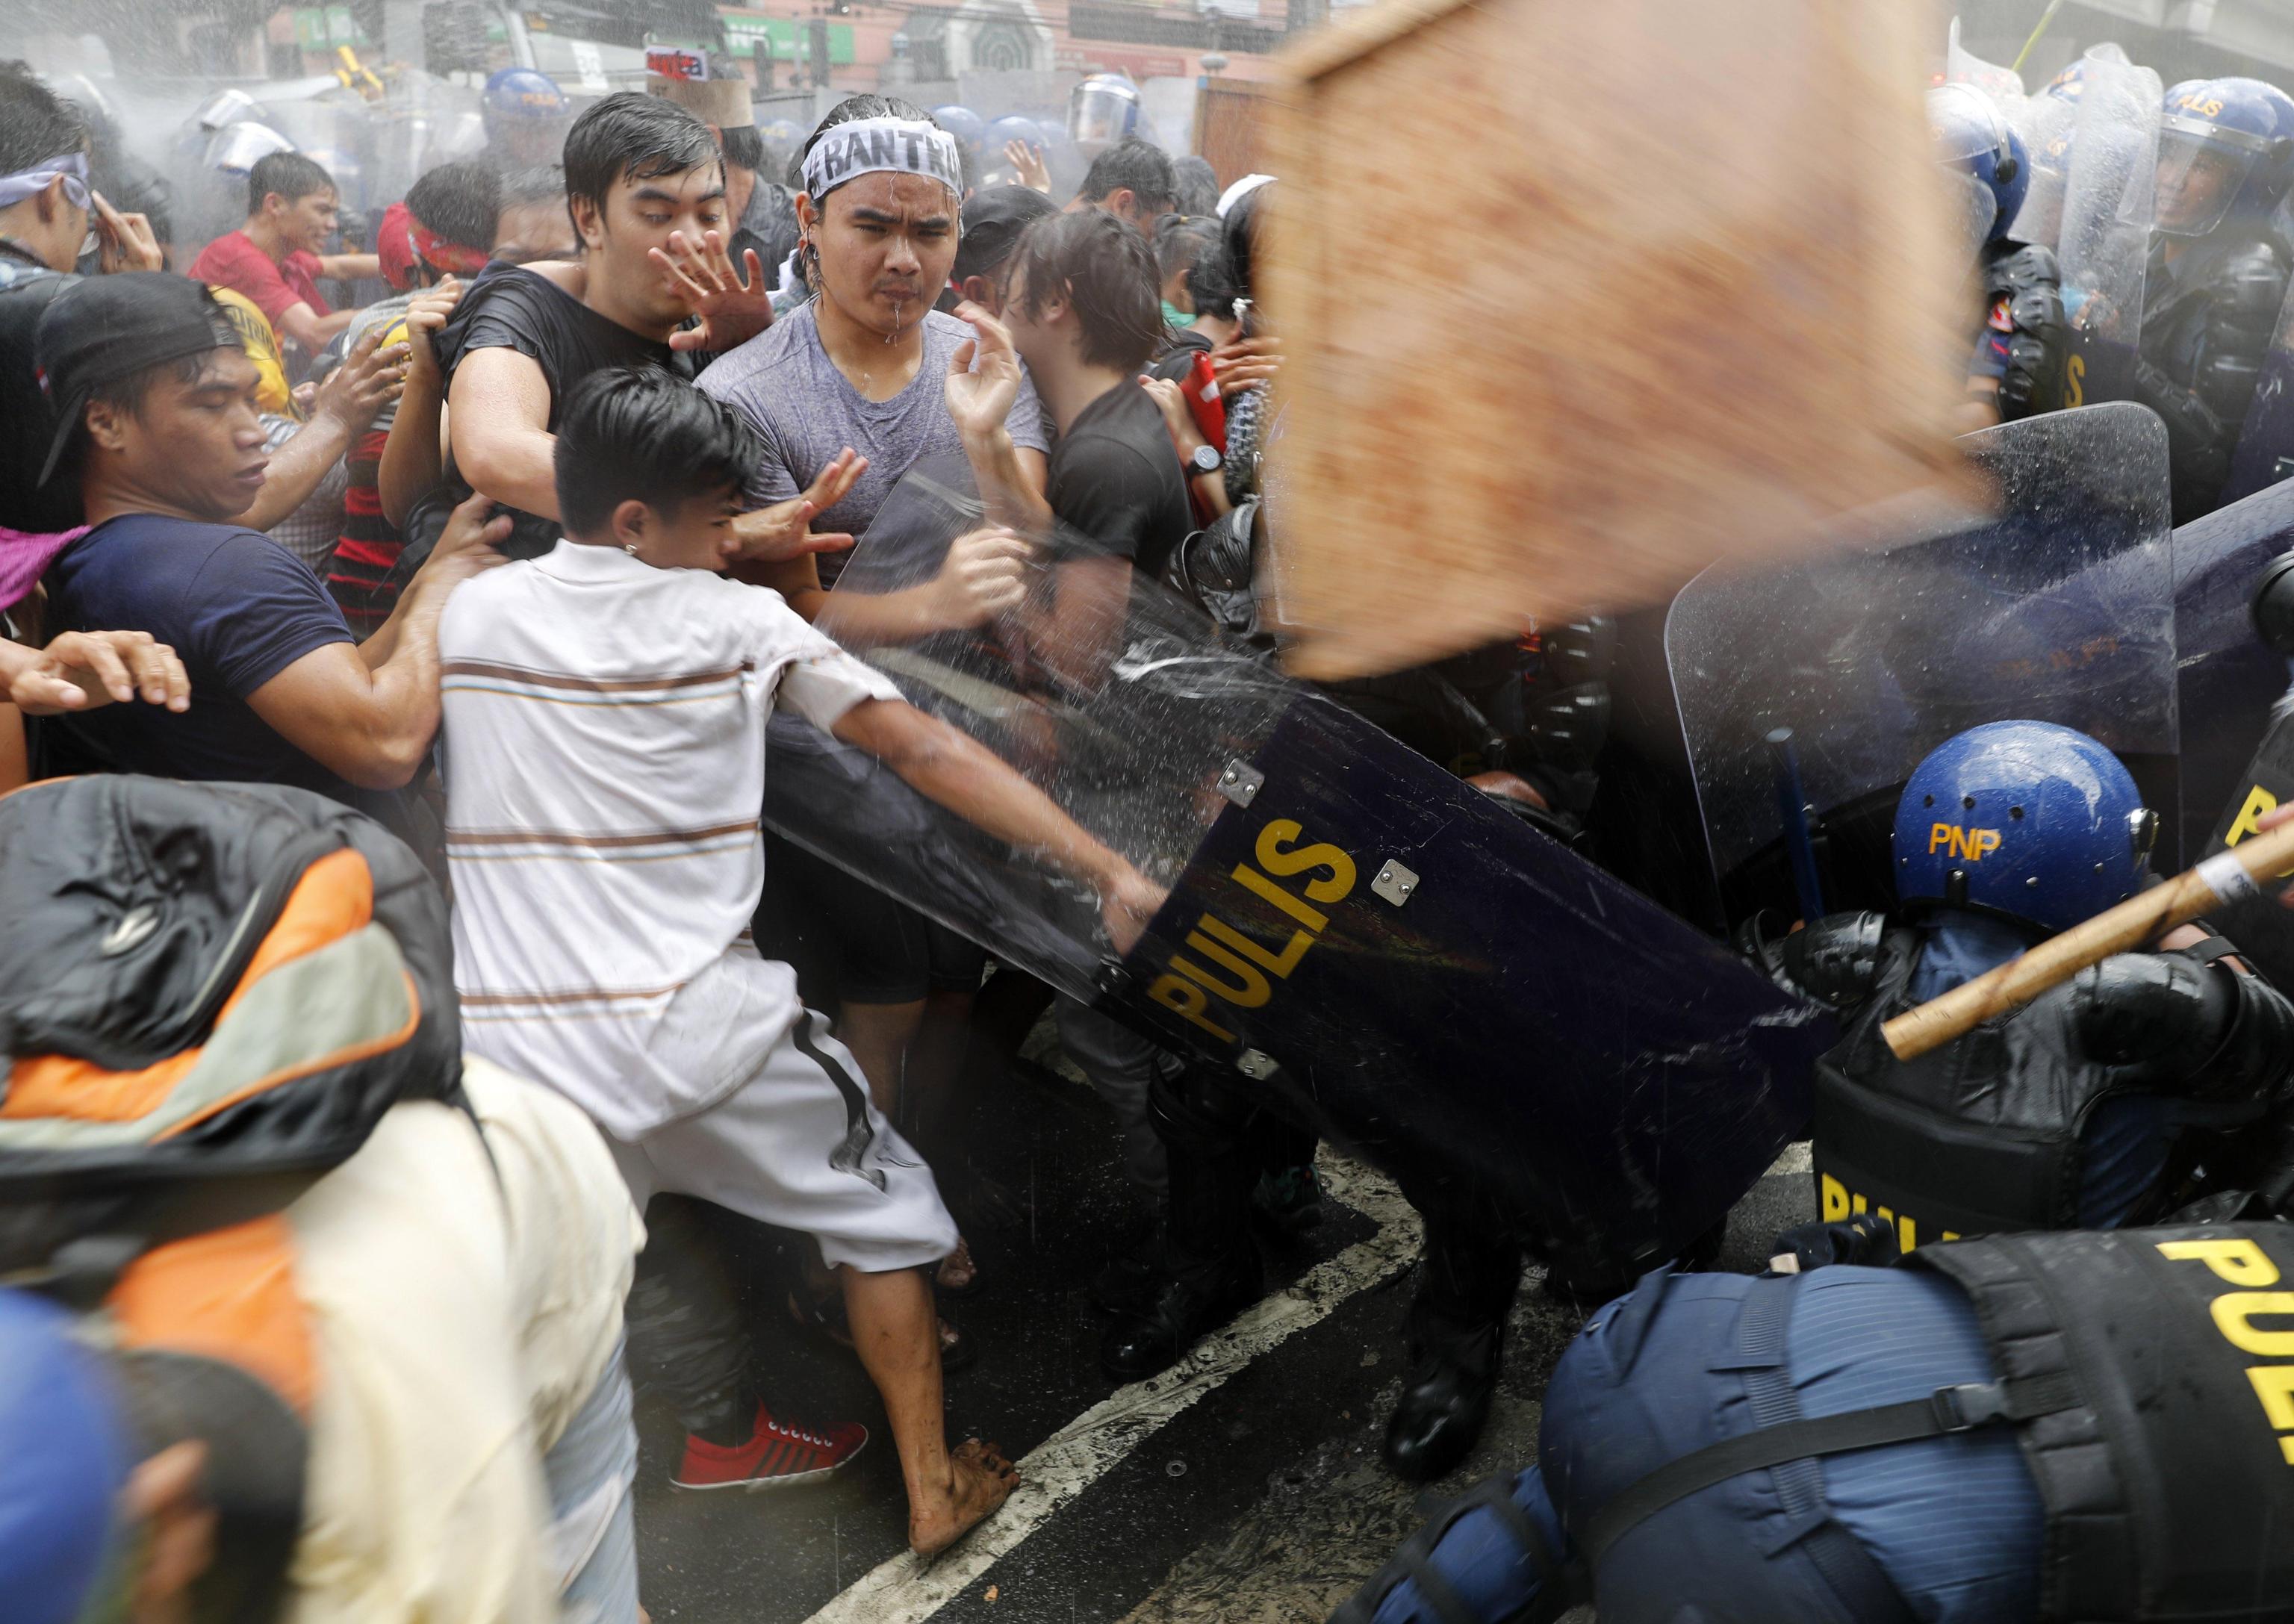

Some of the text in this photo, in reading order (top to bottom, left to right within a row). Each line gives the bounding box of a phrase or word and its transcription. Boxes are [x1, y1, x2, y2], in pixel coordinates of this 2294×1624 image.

[1147, 818, 1357, 1043] PULIS
[1928, 822, 2002, 861] PNP
[2155, 1239, 2294, 1466] PUL
